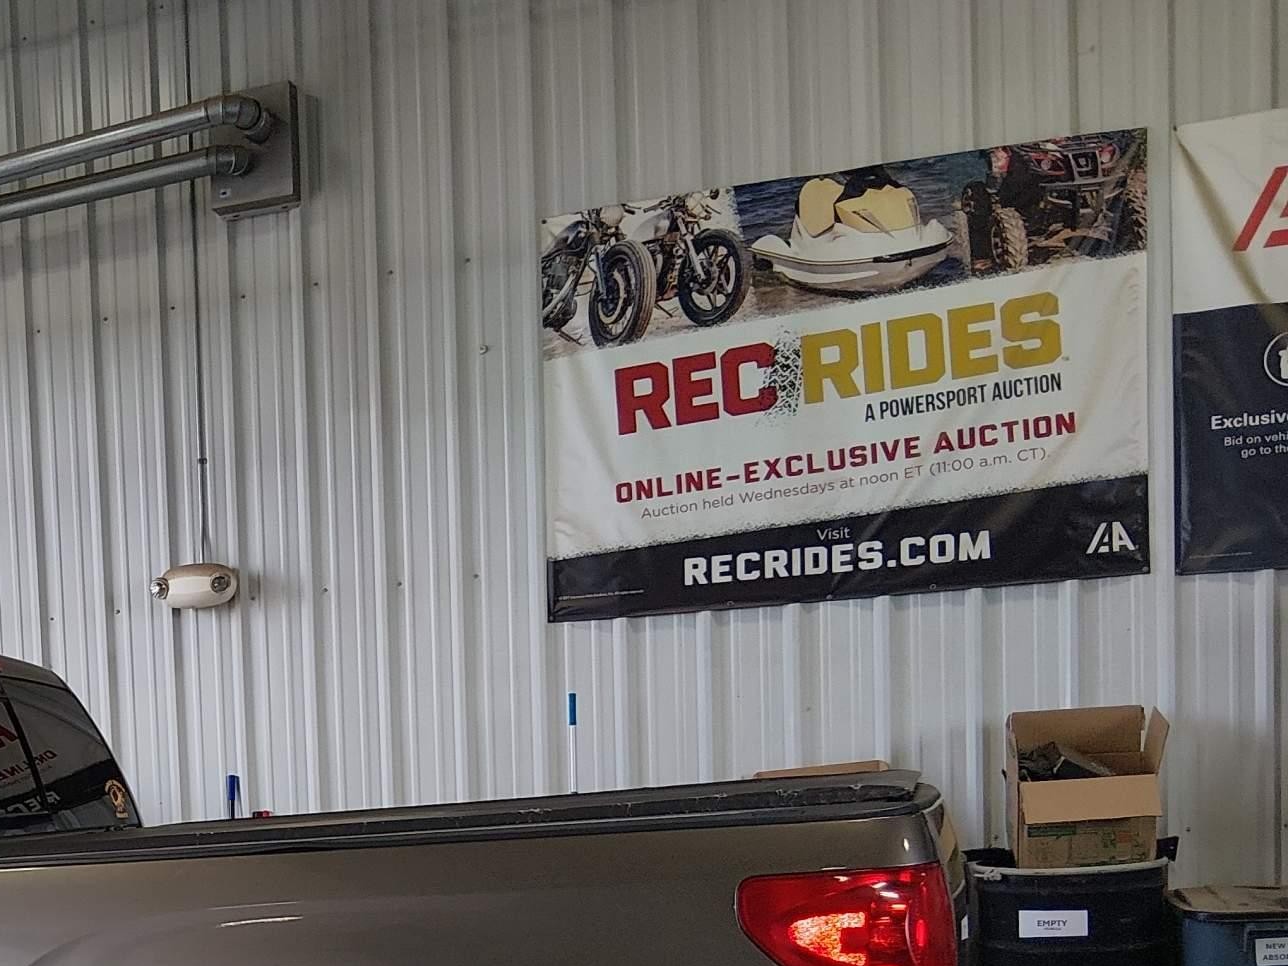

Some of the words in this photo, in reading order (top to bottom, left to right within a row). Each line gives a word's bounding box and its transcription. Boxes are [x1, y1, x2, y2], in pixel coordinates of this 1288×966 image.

[614, 342, 778, 435] REC
[800, 291, 1063, 405] RIDES
[864, 402, 875, 422] A
[878, 386, 989, 420] POWERSPORT
[992, 372, 1062, 400] AUCTION
[1210, 409, 1288, 430] Exclusiv
[615, 435, 921, 503] ONLINE-EXCLUSIVE
[933, 411, 1076, 454] AUCTION
[1224, 434, 1243, 447] Bid
[1246, 435, 1262, 445] on
[1241, 448, 1257, 459] go
[1260, 445, 1272, 455] to
[641, 502, 698, 519] Auction
[702, 493, 734, 511] held
[739, 479, 836, 505] Wednesdays
[839, 476, 855, 489] at
[859, 471, 899, 486] noon
[904, 466, 923, 479] ET
[929, 458, 975, 477] (11:00
[979, 454, 1012, 468] a.m.
[816, 526, 851, 541] Visit
[683, 530, 992, 586] RECRIDES.COM
[1036, 919, 1068, 927] EMPTY
